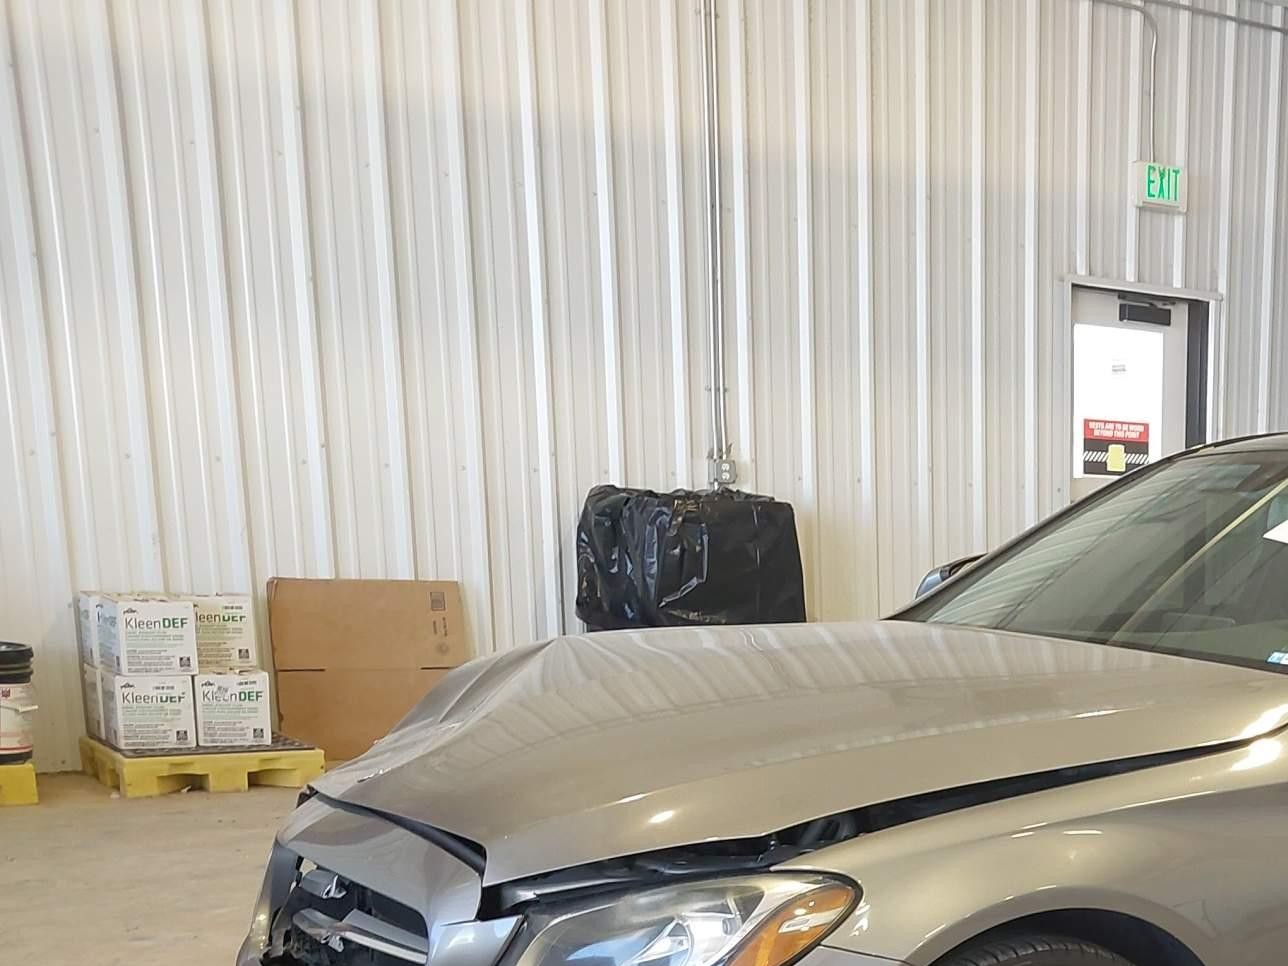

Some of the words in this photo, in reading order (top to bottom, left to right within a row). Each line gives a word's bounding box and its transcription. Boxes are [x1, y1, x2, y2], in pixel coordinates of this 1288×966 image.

[1147, 164, 1181, 201] EXIT
[124, 616, 189, 630] KleenDEF
[121, 691, 186, 705] KleenDEF
